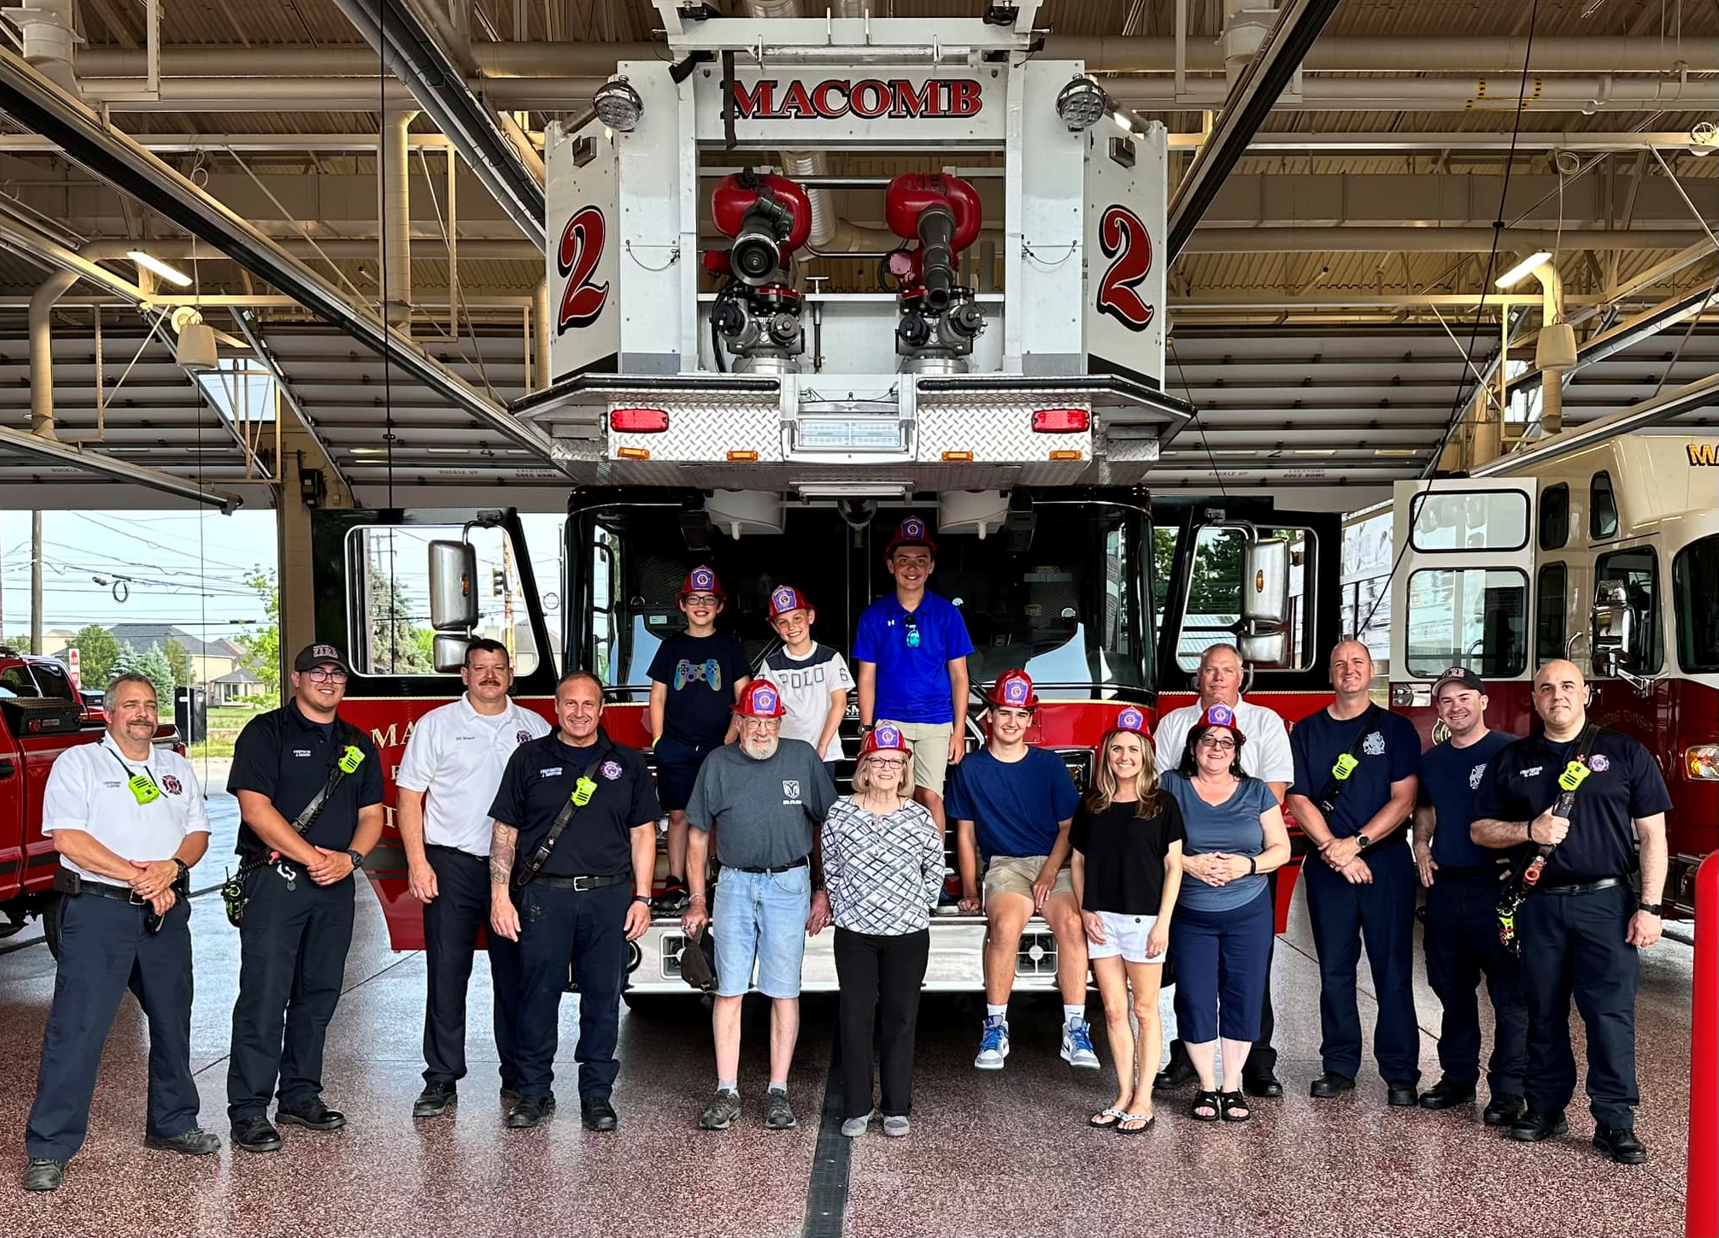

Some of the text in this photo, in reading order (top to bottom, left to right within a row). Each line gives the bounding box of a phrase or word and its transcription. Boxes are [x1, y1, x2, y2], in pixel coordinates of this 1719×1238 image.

[720, 79, 983, 119] MACOMB
[557, 205, 610, 336] 2
[1096, 204, 1155, 332] 2
[779, 667, 824, 689] POLO
[839, 667, 849, 682] 6
